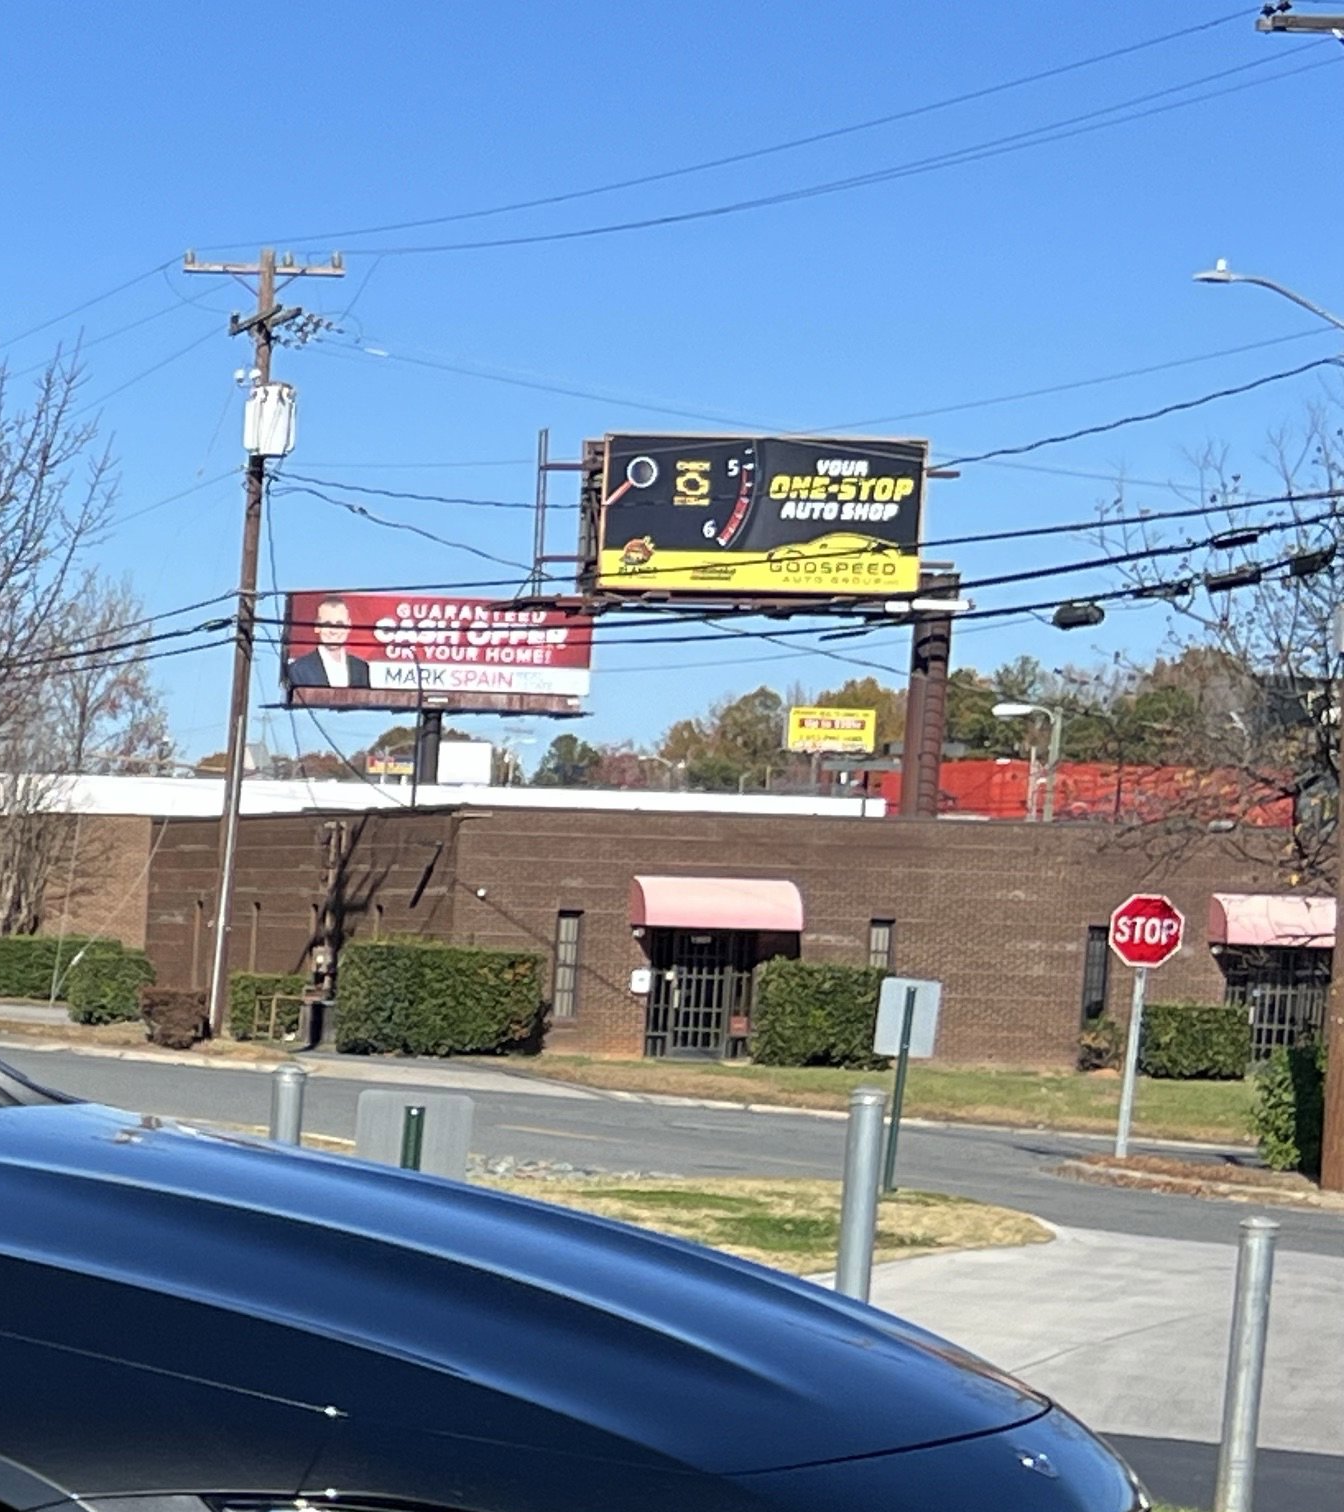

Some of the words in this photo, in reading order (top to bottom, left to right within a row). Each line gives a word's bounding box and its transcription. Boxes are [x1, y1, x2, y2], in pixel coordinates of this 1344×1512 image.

[817, 459, 869, 477] YOUR
[770, 474, 914, 502] ONE-STOP
[781, 502, 839, 520] AUTO
[840, 503, 899, 521] SHOP
[769, 561, 896, 576] GODSPEED
[396, 603, 548, 624] GUARANTEED
[374, 618, 461, 644] CASH
[467, 621, 569, 650] OFFER
[424, 645, 479, 662] YOUR
[485, 647, 552, 665] HOME!
[385, 667, 447, 686] MARK
[450, 670, 514, 688] SPAIN
[1115, 916, 1179, 945] STOP
